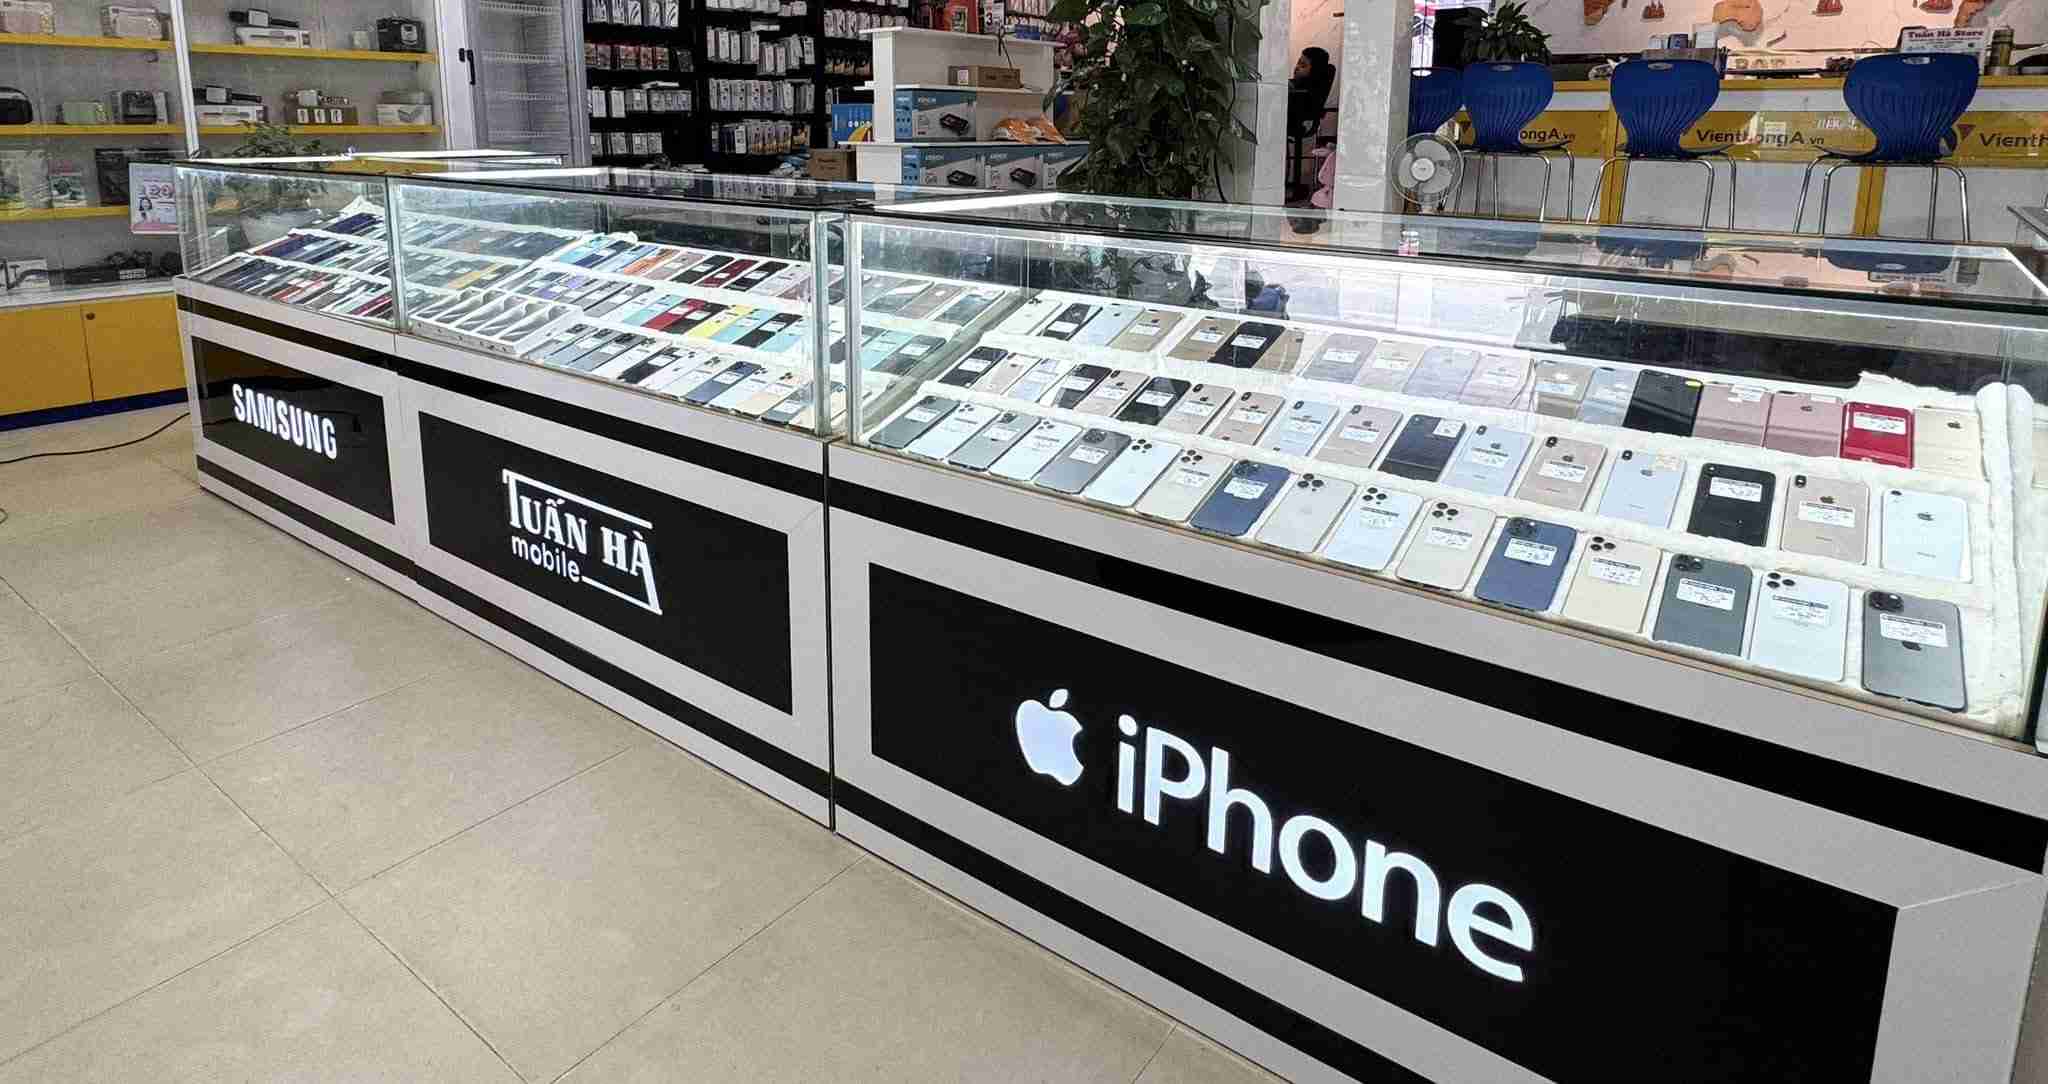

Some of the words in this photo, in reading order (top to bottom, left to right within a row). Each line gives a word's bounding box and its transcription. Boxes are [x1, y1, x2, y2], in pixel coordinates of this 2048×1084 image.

[231, 383, 338, 461] SAMSUNG
[502, 468, 590, 555] TUẤN
[511, 535, 581, 583] mobile
[1116, 714, 1535, 983] iPhone
